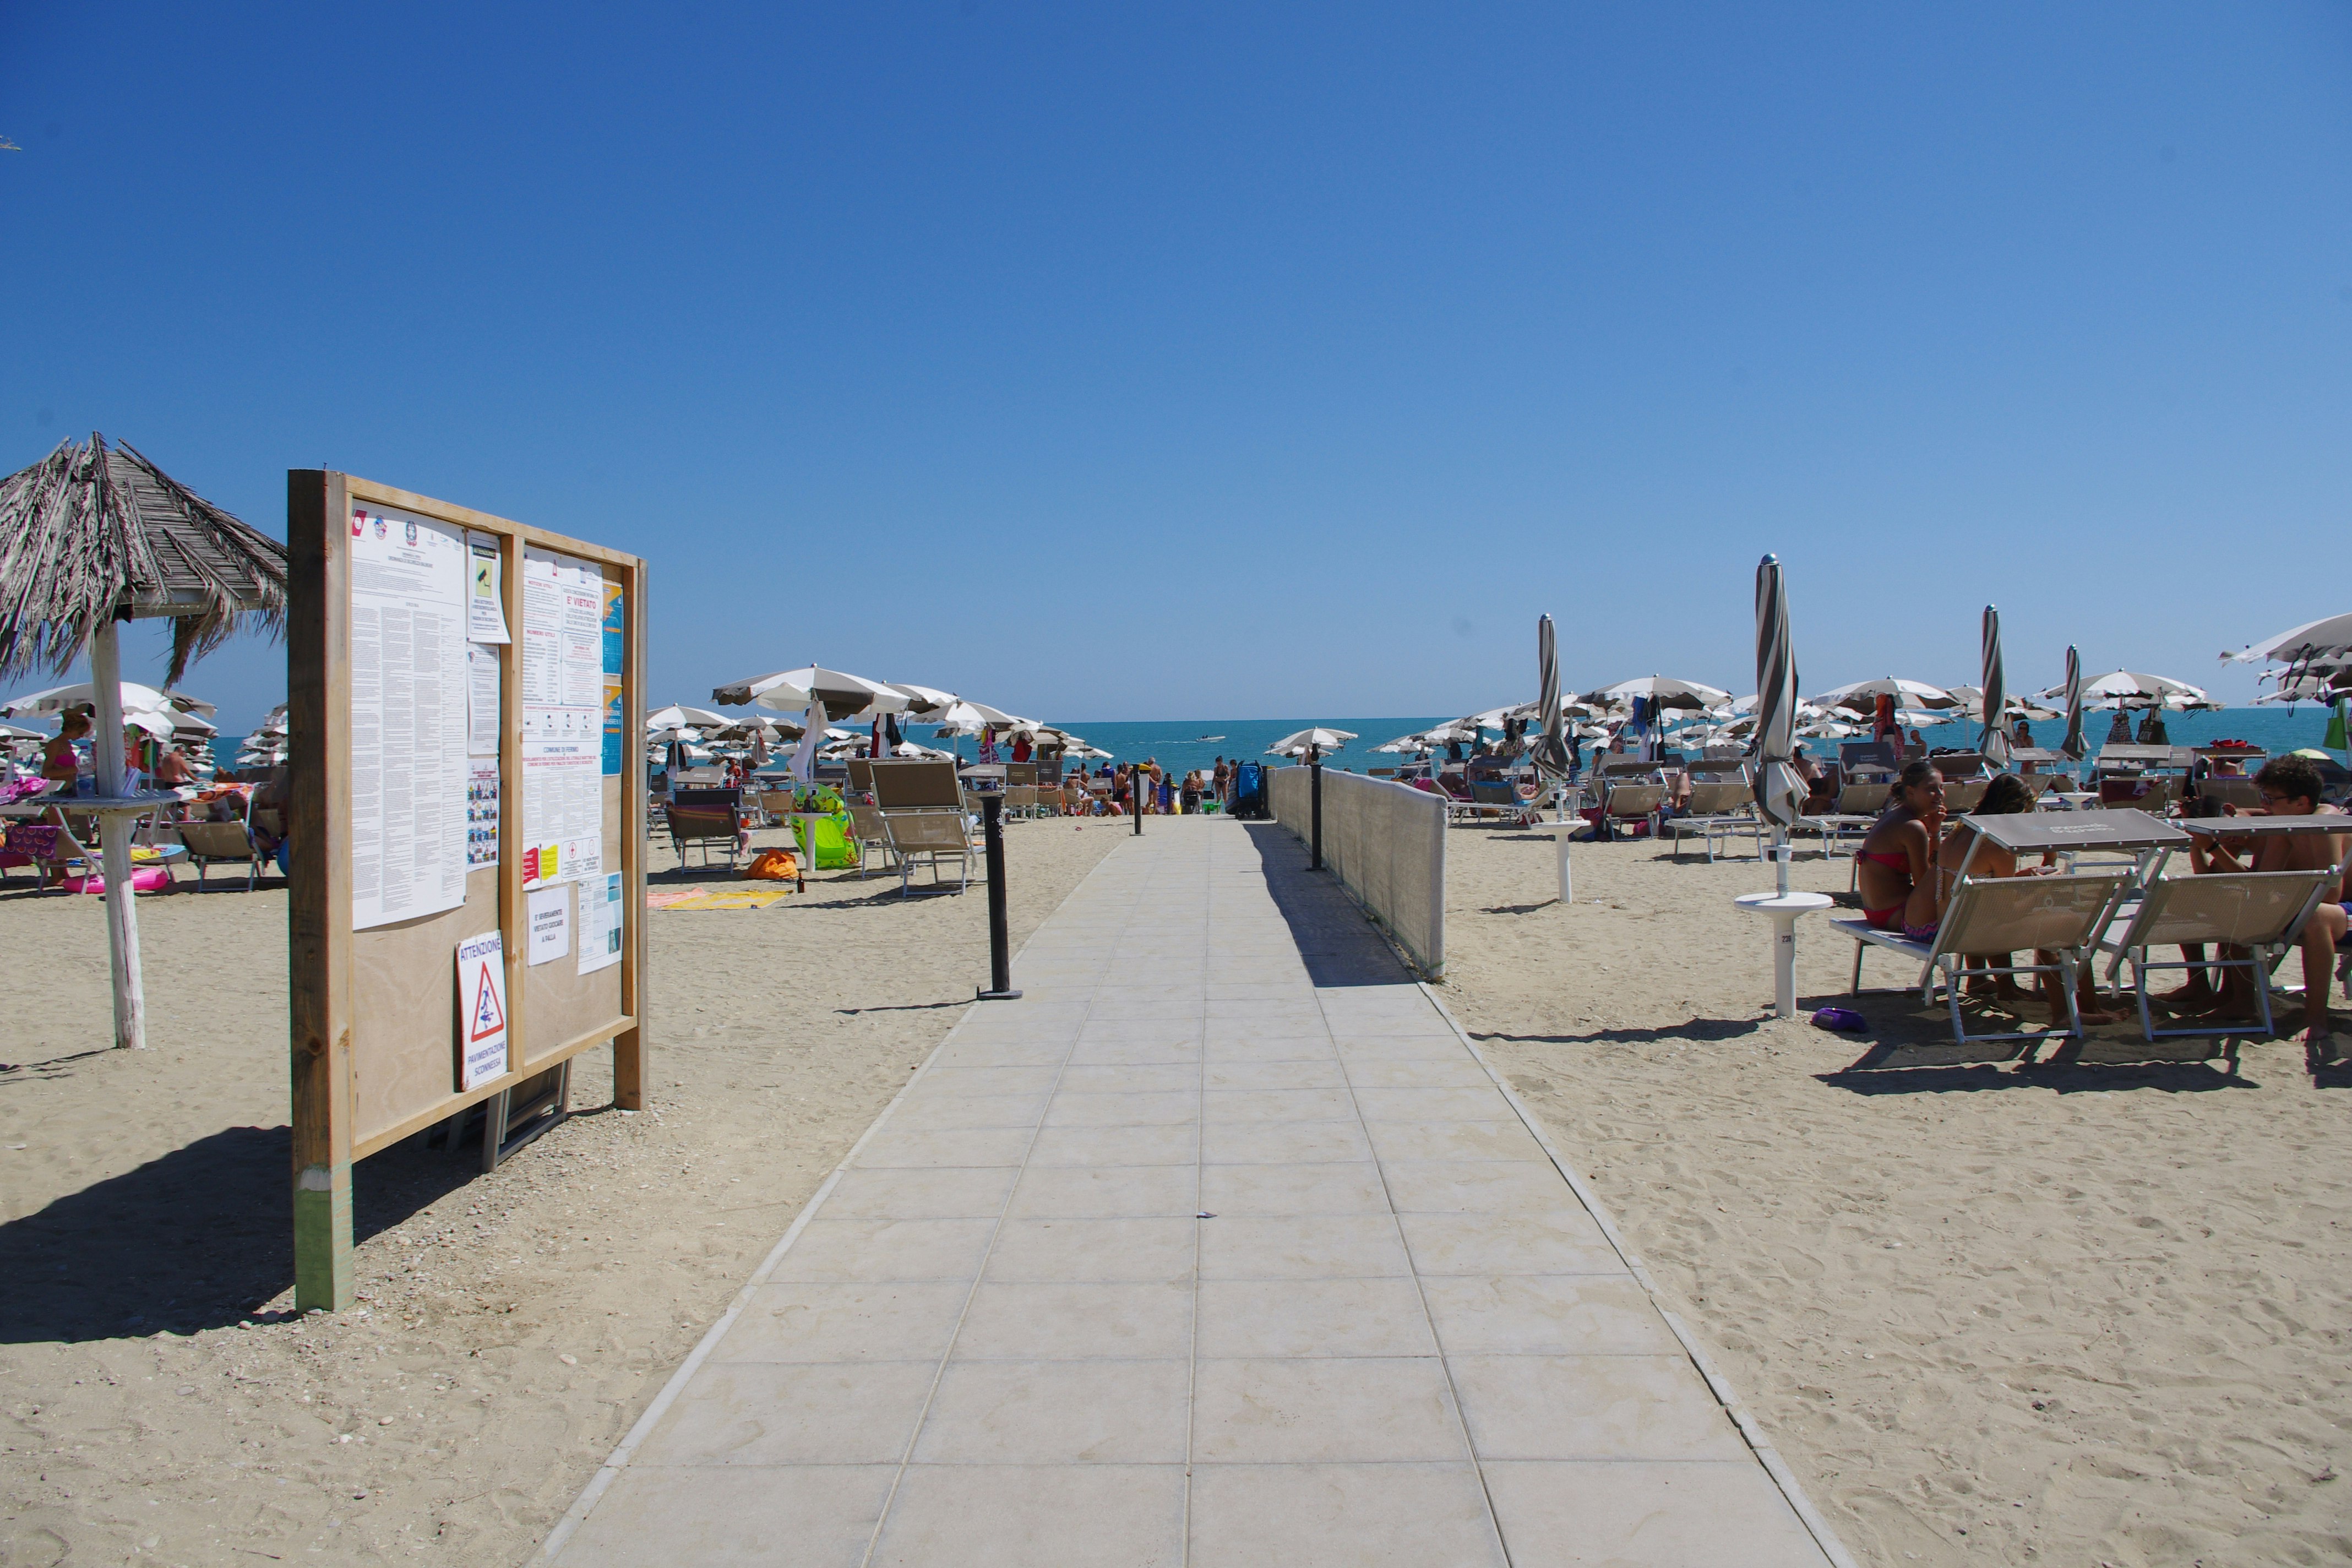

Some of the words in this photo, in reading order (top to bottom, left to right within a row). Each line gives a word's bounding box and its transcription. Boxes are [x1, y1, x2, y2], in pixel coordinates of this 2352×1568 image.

[574, 597, 596, 609] VIETATO
[533, 923, 548, 932] VIETATO
[549, 919, 564, 929] GIOCARE
[545, 933, 556, 942] PALLA
[460, 938, 501, 962] ATTENZIONE
[468, 1040, 505, 1065] PAVIMENTAZIONE
[475, 1057, 501, 1076] SCONNESSA
